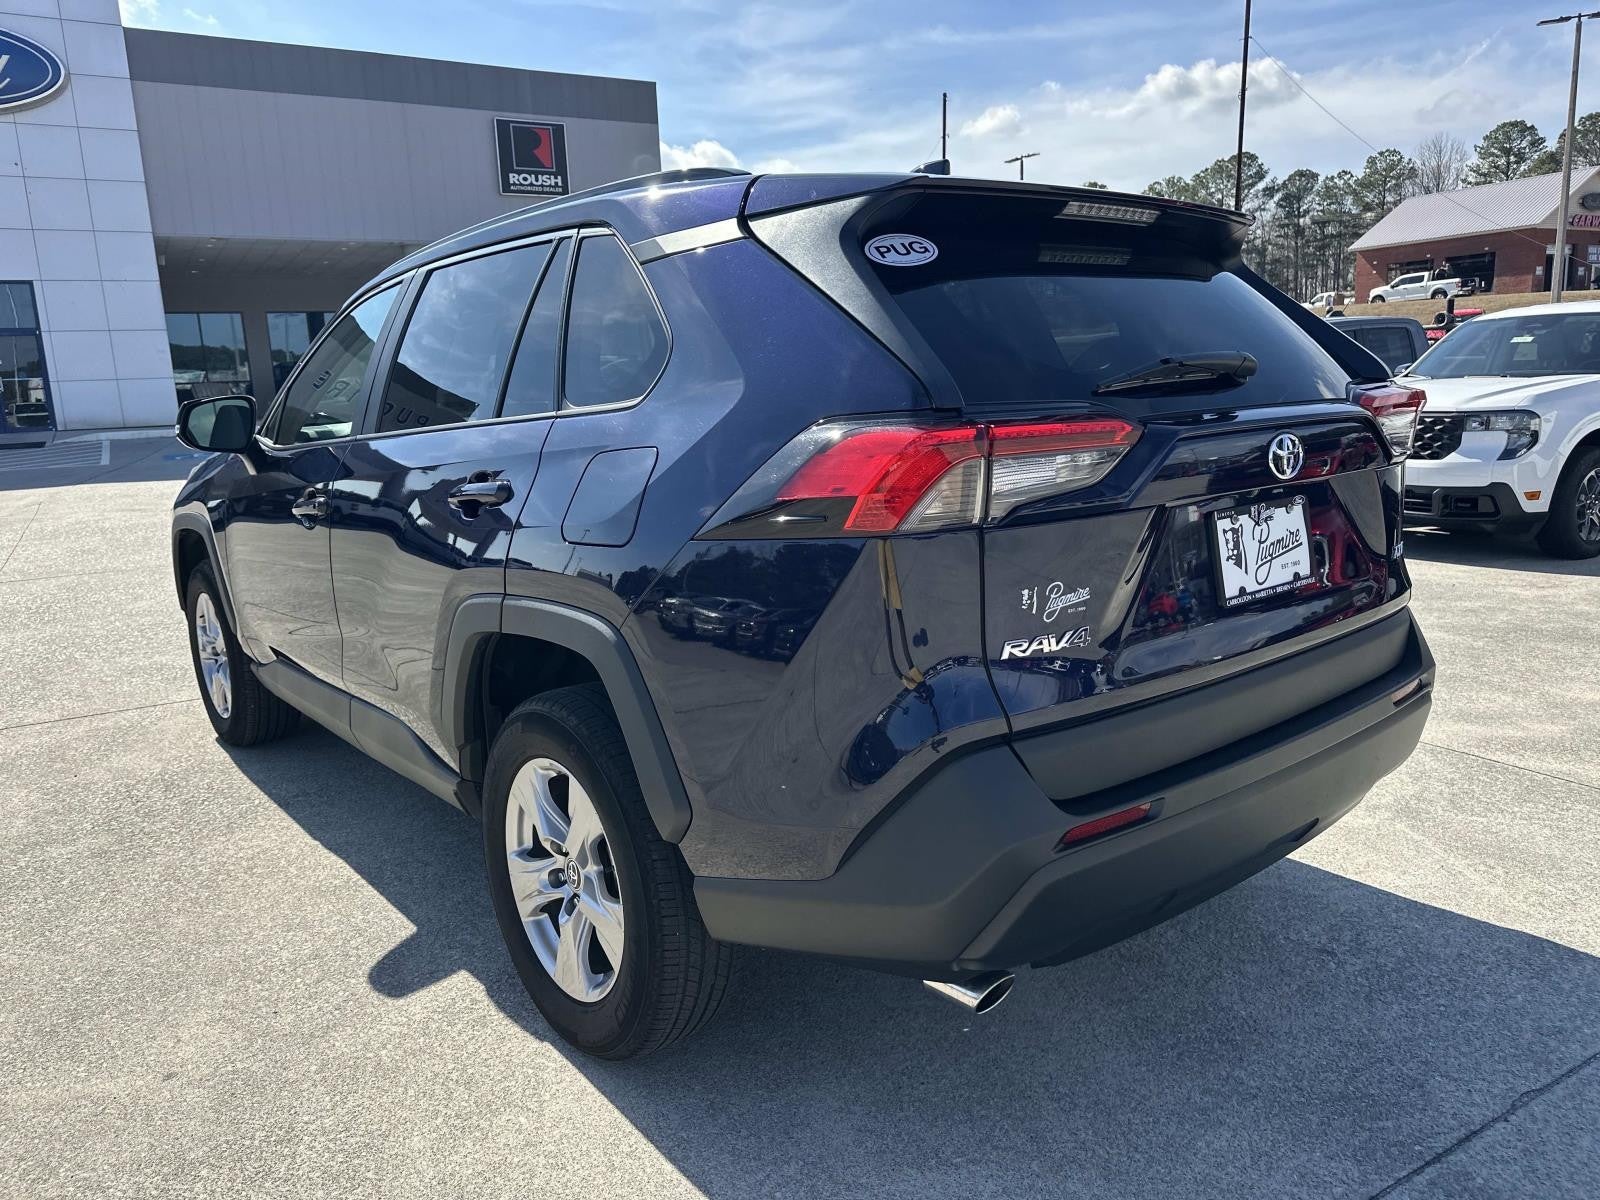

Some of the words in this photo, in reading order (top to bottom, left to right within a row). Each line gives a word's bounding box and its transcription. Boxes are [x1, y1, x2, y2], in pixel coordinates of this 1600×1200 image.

[509, 173, 562, 186] ROUSH
[873, 241, 930, 259] PUG
[1252, 522, 1303, 585] Pugmire
[1043, 581, 1091, 622] Pugmire
[1000, 626, 1091, 660] RAV4
